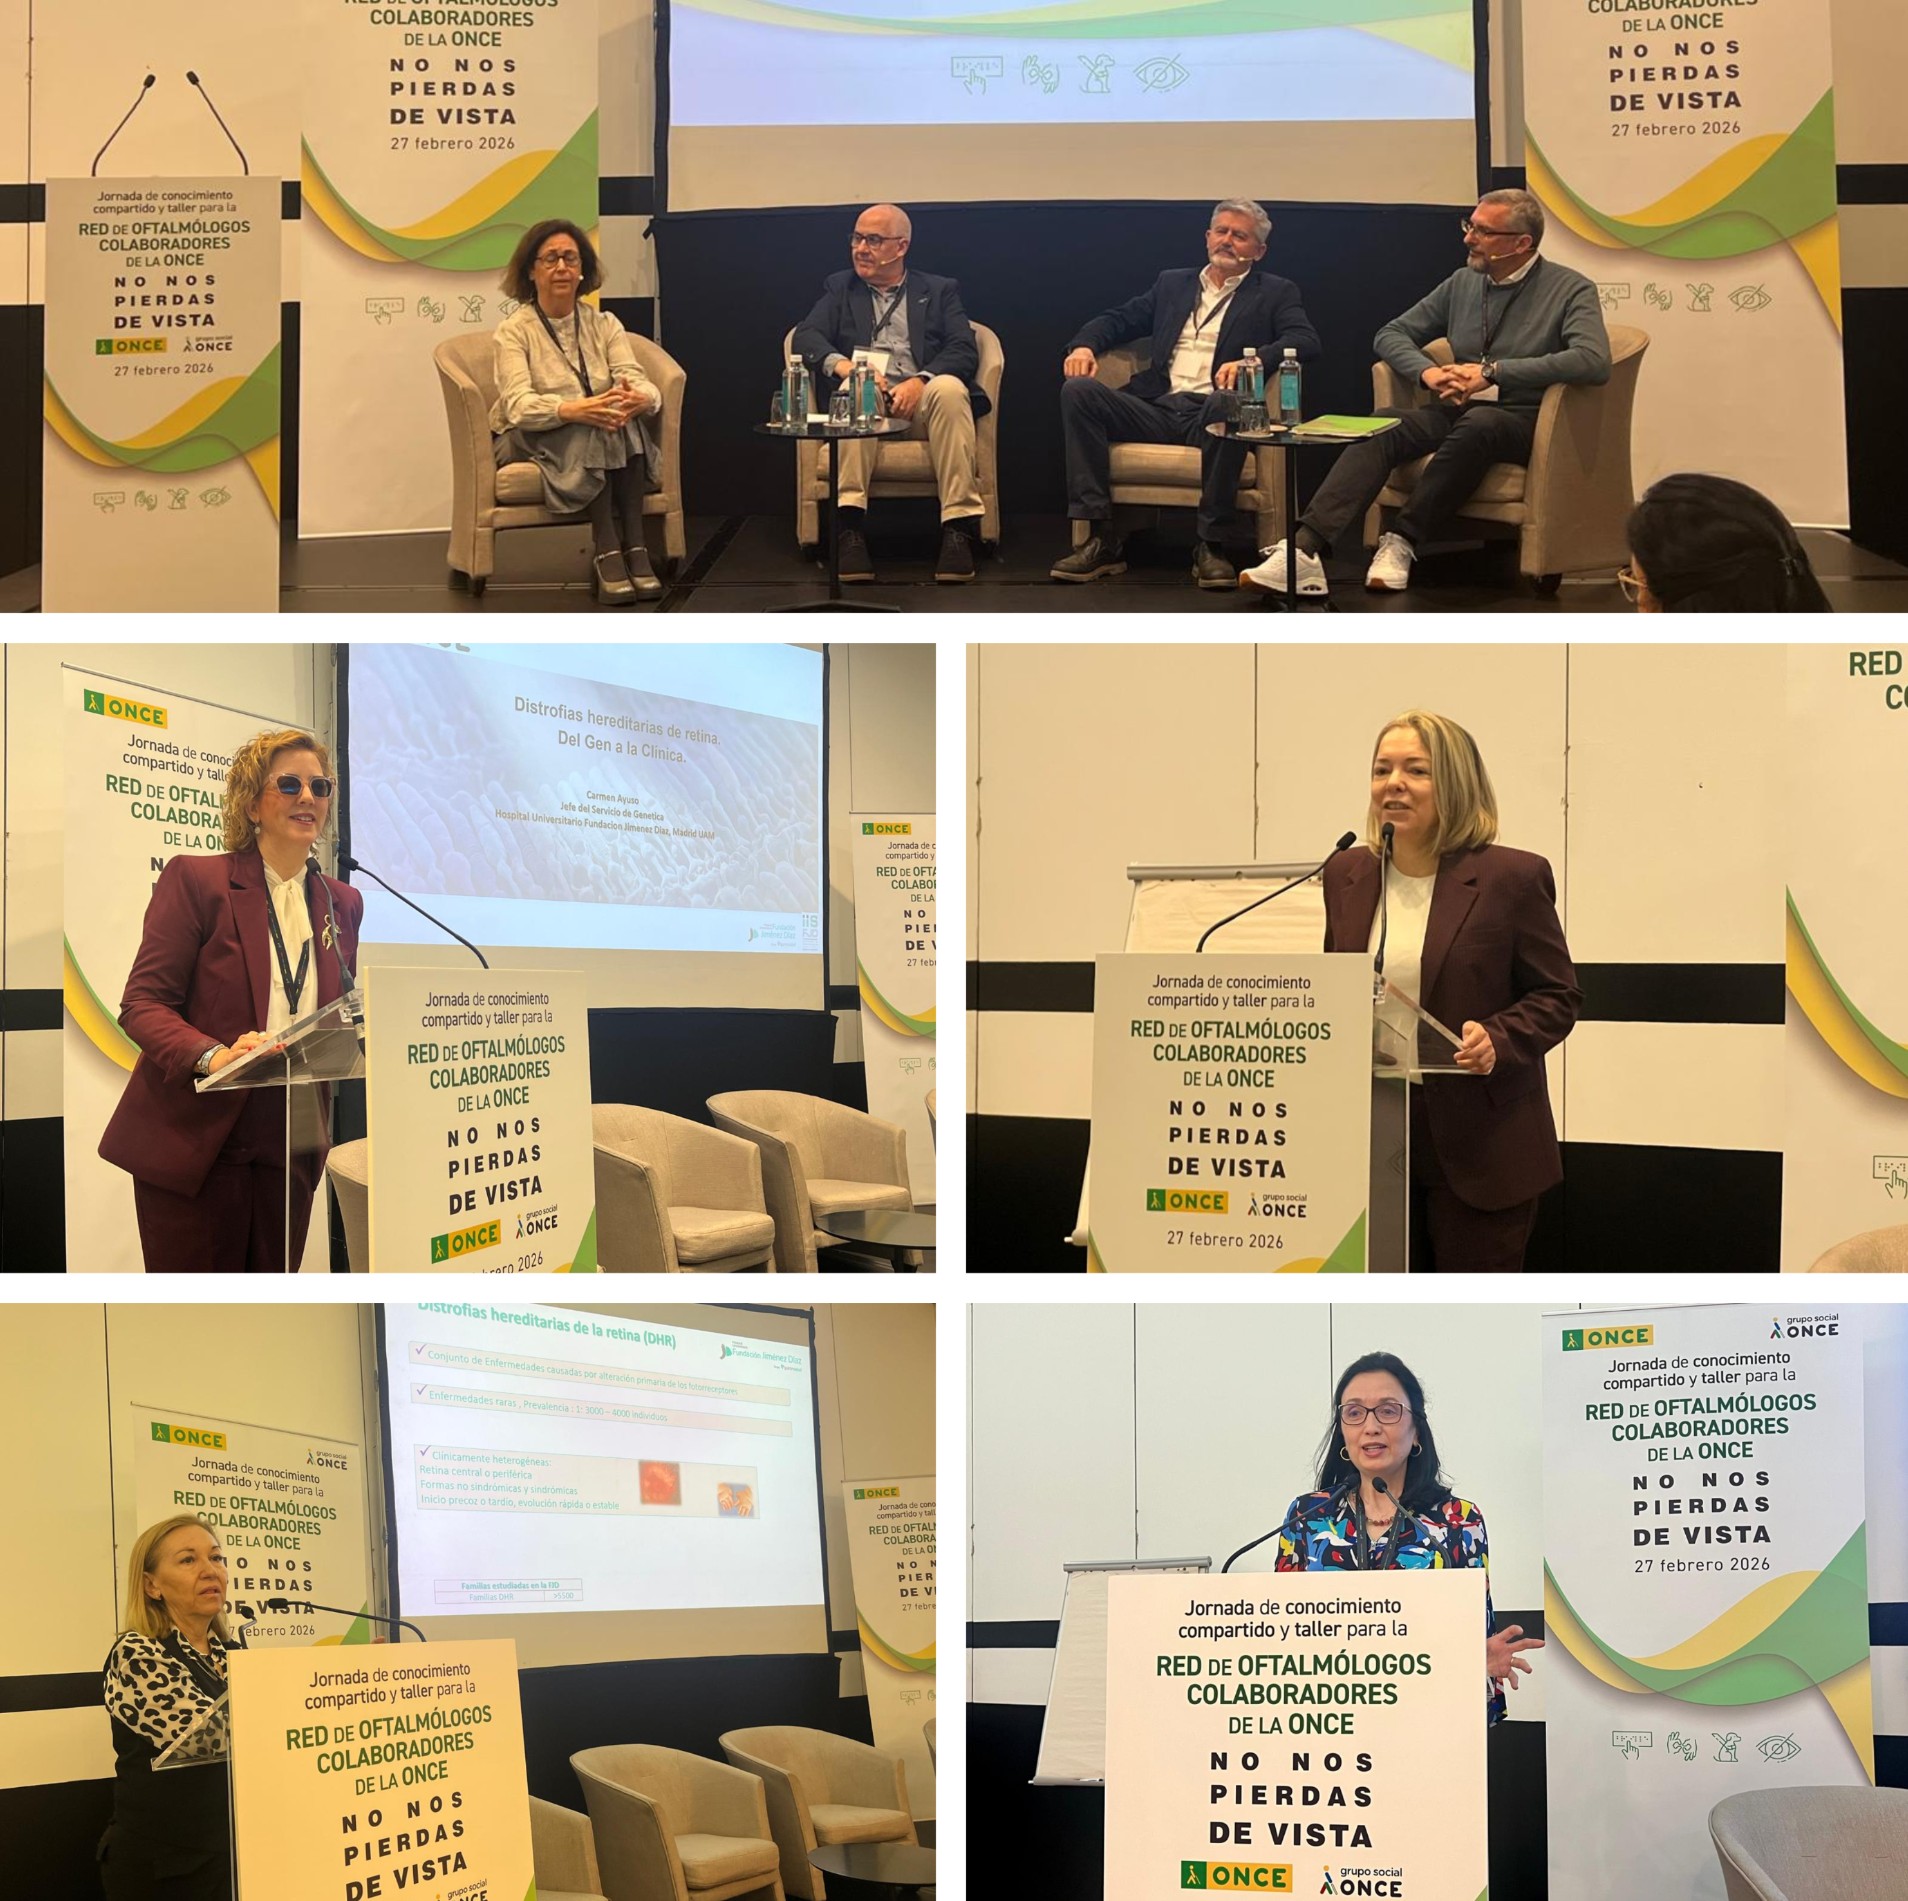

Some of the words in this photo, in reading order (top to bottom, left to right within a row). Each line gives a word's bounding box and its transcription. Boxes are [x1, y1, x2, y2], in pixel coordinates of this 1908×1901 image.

[370, 10, 534, 26] COLABORADORES
[405, 34, 424, 46] DE
[429, 34, 447, 46] LA
[452, 31, 501, 46] ONCE
[1609, 45, 1648, 59] NO
[1675, 41, 1739, 56] NOS
[390, 82, 515, 95] PIERDAS
[390, 109, 424, 124] DE
[437, 109, 516, 124] VISTA
[1612, 125, 1629, 136] 27
[1636, 123, 1695, 136] febrero
[1703, 121, 1740, 134] 2026
[97, 191, 142, 201] Jornada
[146, 191, 158, 201] de
[162, 191, 233, 200] conocimiento
[79, 224, 108, 235] RED
[113, 225, 127, 235] DE
[132, 219, 250, 235] OFTALMÓLOGOS
[100, 237, 230, 251] COLABORADORES
[117, 340, 163, 351] ONCE
[114, 367, 128, 376] 27
[134, 366, 179, 375] febrero
[185, 364, 213, 374] 2026
[1850, 650, 1902, 676] RED
[109, 699, 163, 725] ONCE
[515, 696, 583, 721] Distrofias
[588, 710, 663, 736] hereditarias
[668, 725, 681, 738] de
[685, 730, 720, 745] retina.
[559, 730, 580, 746] Del
[585, 734, 611, 751] Gen
[616, 743, 623, 753] a
[627, 741, 637, 756] la
[587, 791, 615, 802] Carmen
[617, 795, 639, 805] Ayuso
[131, 801, 222, 830] COLABORA
[560, 802, 576, 812] Jefe
[578, 804, 590, 813] del
[592, 806, 621, 816] Servicio
[623, 809, 632, 818] de
[496, 809, 530, 821] Hospital
[532, 814, 582, 826] Universitario
[673, 828, 697, 838] Madrid
[877, 825, 908, 833] ONCE
[164, 832, 181, 845] DE
[185, 833, 201, 847] LA
[206, 834, 226, 851] ON
[911, 894, 921, 902] DE
[904, 910, 925, 918] NO
[1153, 975, 1204, 989] Jornada
[1208, 976, 1222, 988] de
[1226, 975, 1310, 990] conocimiento
[408, 1043, 439, 1064] RED
[443, 1046, 458, 1062] DE
[462, 1033, 565, 1060] OFTALMÓLOGOS
[1169, 1101, 1206, 1116] NO
[1230, 1102, 1287, 1118] NOS
[449, 1144, 541, 1178] PIERDAS
[1170, 1193, 1224, 1210] ONCE
[526, 1209, 542, 1221] grupo
[543, 1204, 557, 1217] social
[526, 1215, 558, 1236] ONCE
[1168, 1231, 1183, 1244] 27
[1190, 1232, 1243, 1247] febrero
[1249, 1234, 1283, 1249] 2026
[518, 1251, 543, 1272] 2026
[1787, 1316, 1812, 1325] grupo
[1814, 1314, 1839, 1322] social
[491, 1307, 570, 1332] hereditarias
[574, 1321, 589, 1334] de
[593, 1323, 603, 1336] la
[607, 1327, 640, 1342] retina
[644, 1331, 676, 1350] (DHR)
[1589, 1328, 1648, 1345] ONCE
[1787, 1324, 1839, 1338] ONCE
[428, 1350, 469, 1363] Conjunto
[472, 1356, 482, 1365] de
[485, 1358, 544, 1372] Enfermedades
[547, 1366, 582, 1377] causadas
[585, 1370, 597, 1380] por
[637, 1377, 665, 1387] primaria
[667, 1380, 676, 1388] de
[678, 1381, 687, 1389] los
[1609, 1358, 1667, 1373] Jornada
[1671, 1357, 1688, 1369] de
[1693, 1352, 1790, 1367] conocimiento
[430, 1391, 493, 1405] Enfermedades
[524, 1400, 569, 1412] Prevalencia
[585, 1407, 604, 1415] 3000
[612, 1408, 630, 1417] 4000
[174, 1429, 223, 1448] ONCE
[316, 1451, 332, 1459] grupo
[192, 1457, 237, 1472] Jornada
[241, 1464, 253, 1474] de
[257, 1467, 320, 1484] conocimiento
[316, 1458, 347, 1470] ONCE
[420, 1465, 449, 1475] Retina
[452, 1468, 482, 1476] central
[421, 1480, 454, 1490] Formas
[524, 1486, 528, 1494] y
[867, 1489, 896, 1497] ONCE
[422, 1495, 446, 1504] Inicio
[449, 1496, 477, 1506] precoz
[898, 1573, 933, 1582] PIER
[1178, 1622, 1275, 1641] compartido
[1280, 1625, 1290, 1640] y
[1295, 1622, 1342, 1637] taller
[1348, 1624, 1386, 1640] para
[1391, 1621, 1407, 1636] la
[1187, 1683, 1398, 1705] COLABORADORES
[286, 1725, 328, 1750] RED
[334, 1725, 354, 1743] DE
[359, 1705, 492, 1739] OFTALMÓLOGOS
[344, 1820, 464, 1866] PIERDAS
[1212, 1867, 1286, 1888] ONCE
[1341, 1869, 1371, 1878] grupo
[1374, 1867, 1402, 1877] social
[1341, 1880, 1402, 1898] ONCE
